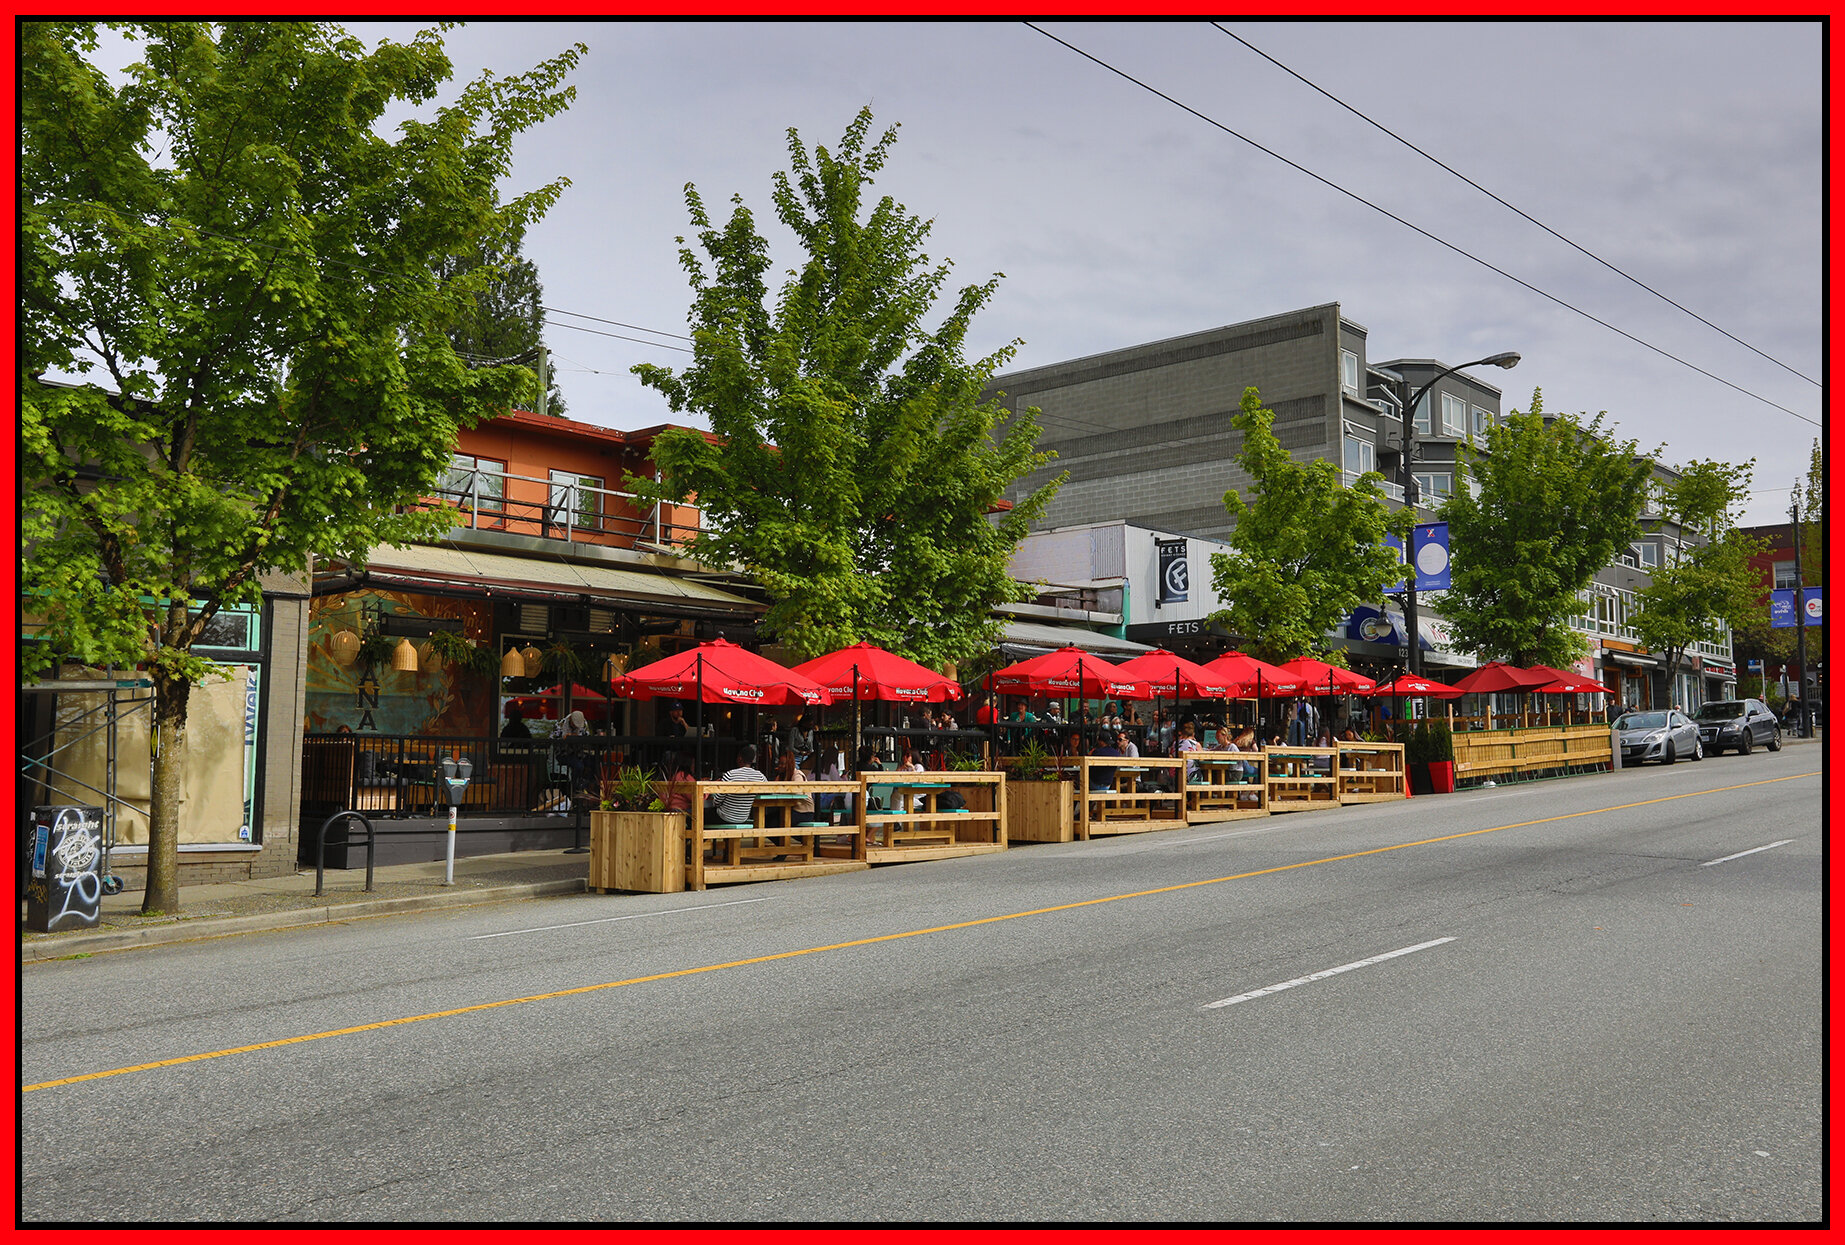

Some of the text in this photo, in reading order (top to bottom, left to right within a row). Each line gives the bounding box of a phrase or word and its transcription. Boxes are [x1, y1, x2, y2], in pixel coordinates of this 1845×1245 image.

[1160, 545, 1186, 554] FETS
[1168, 622, 1199, 634] FETS
[356, 600, 384, 731] HAANA
[723, 687, 748, 697] Havana
